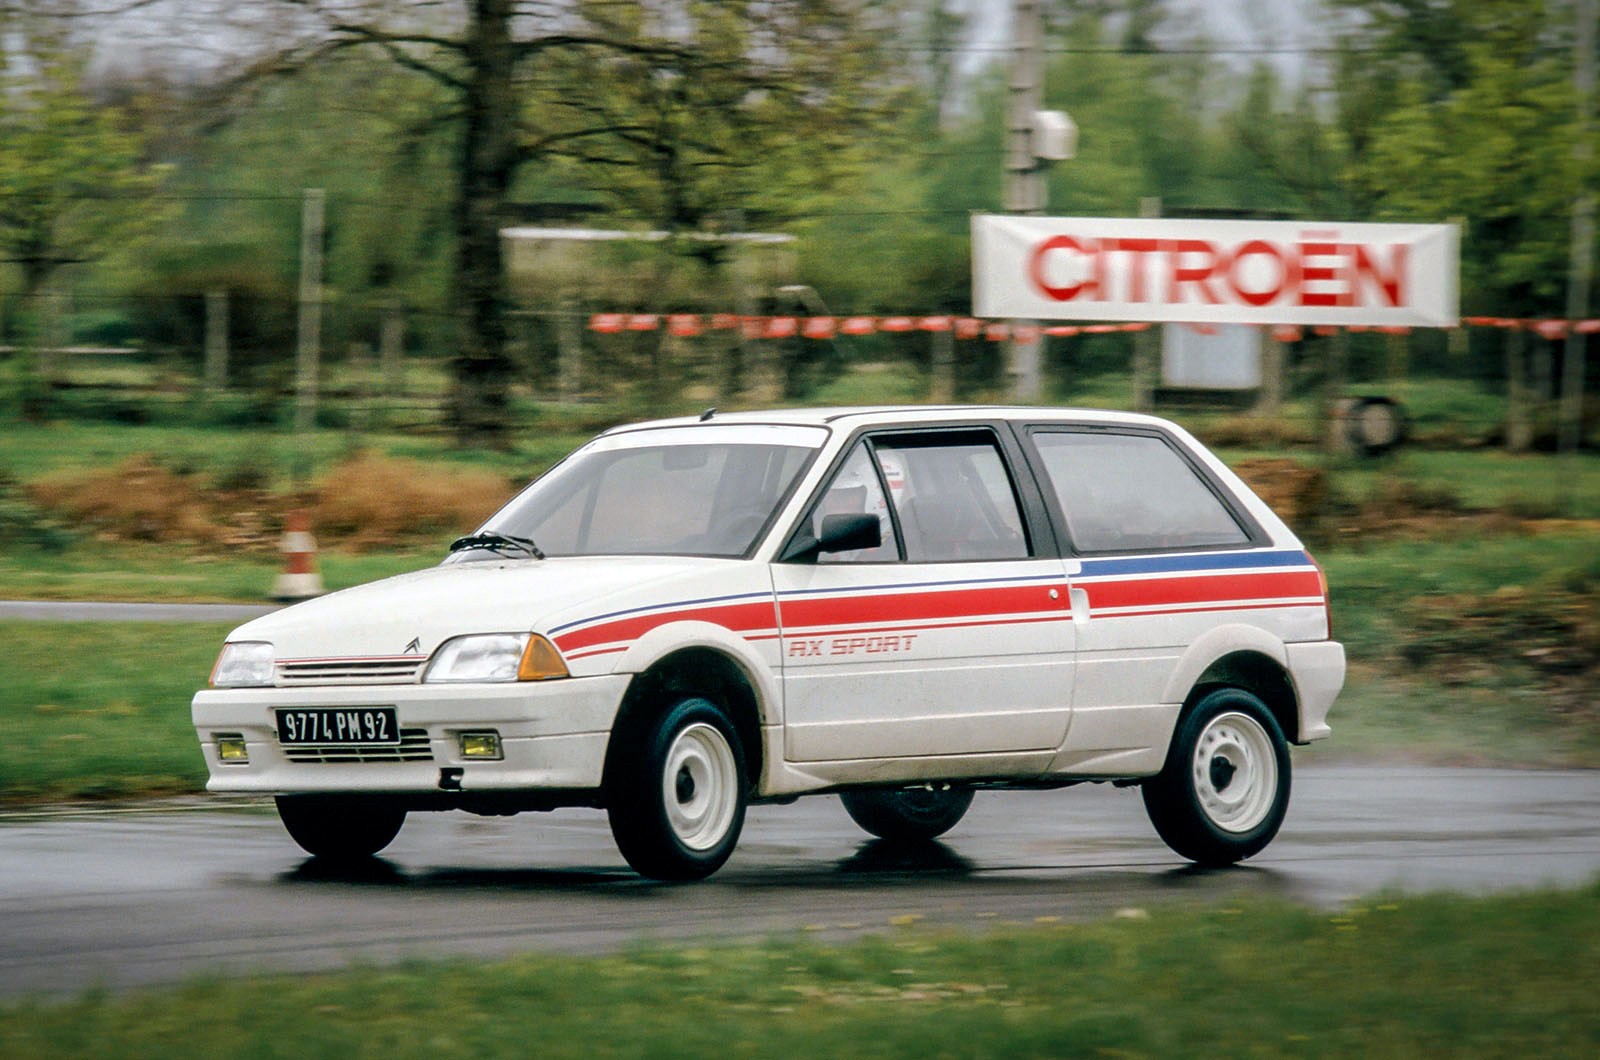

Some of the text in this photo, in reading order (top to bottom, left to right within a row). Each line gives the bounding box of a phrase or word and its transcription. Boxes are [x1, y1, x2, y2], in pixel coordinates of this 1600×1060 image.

[1031, 230, 1411, 308] CITROËN
[789, 634, 918, 657] AX SPORT
[286, 712, 389, 740] 9774 PM 92
